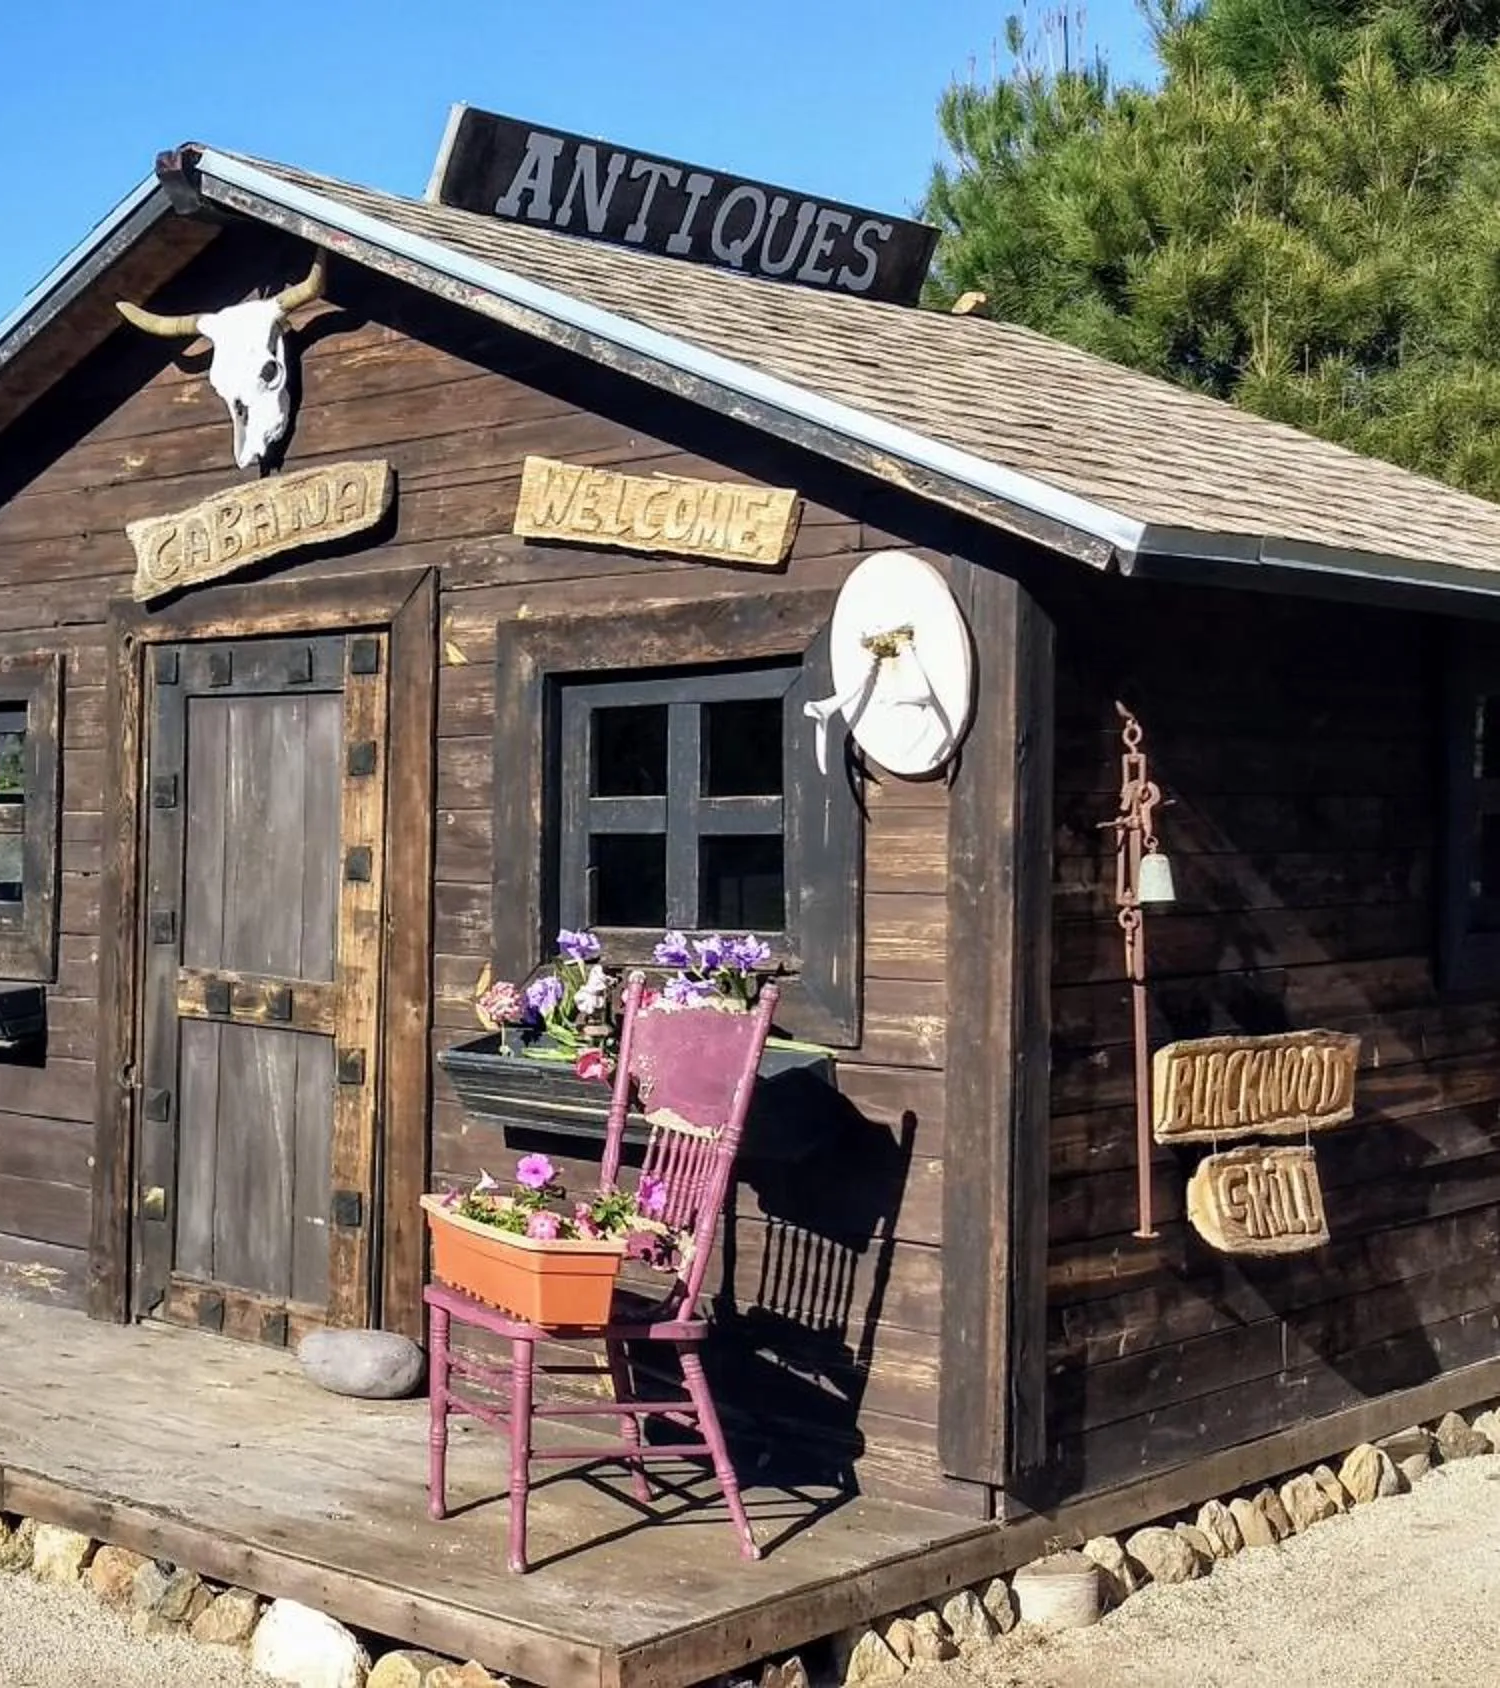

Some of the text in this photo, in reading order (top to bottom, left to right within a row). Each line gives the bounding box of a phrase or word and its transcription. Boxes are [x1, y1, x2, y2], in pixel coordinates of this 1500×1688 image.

[495, 131, 893, 292] ANTIQUES
[530, 466, 769, 557] WELCOME
[1169, 1046, 1347, 1129] BLACKWOOD
